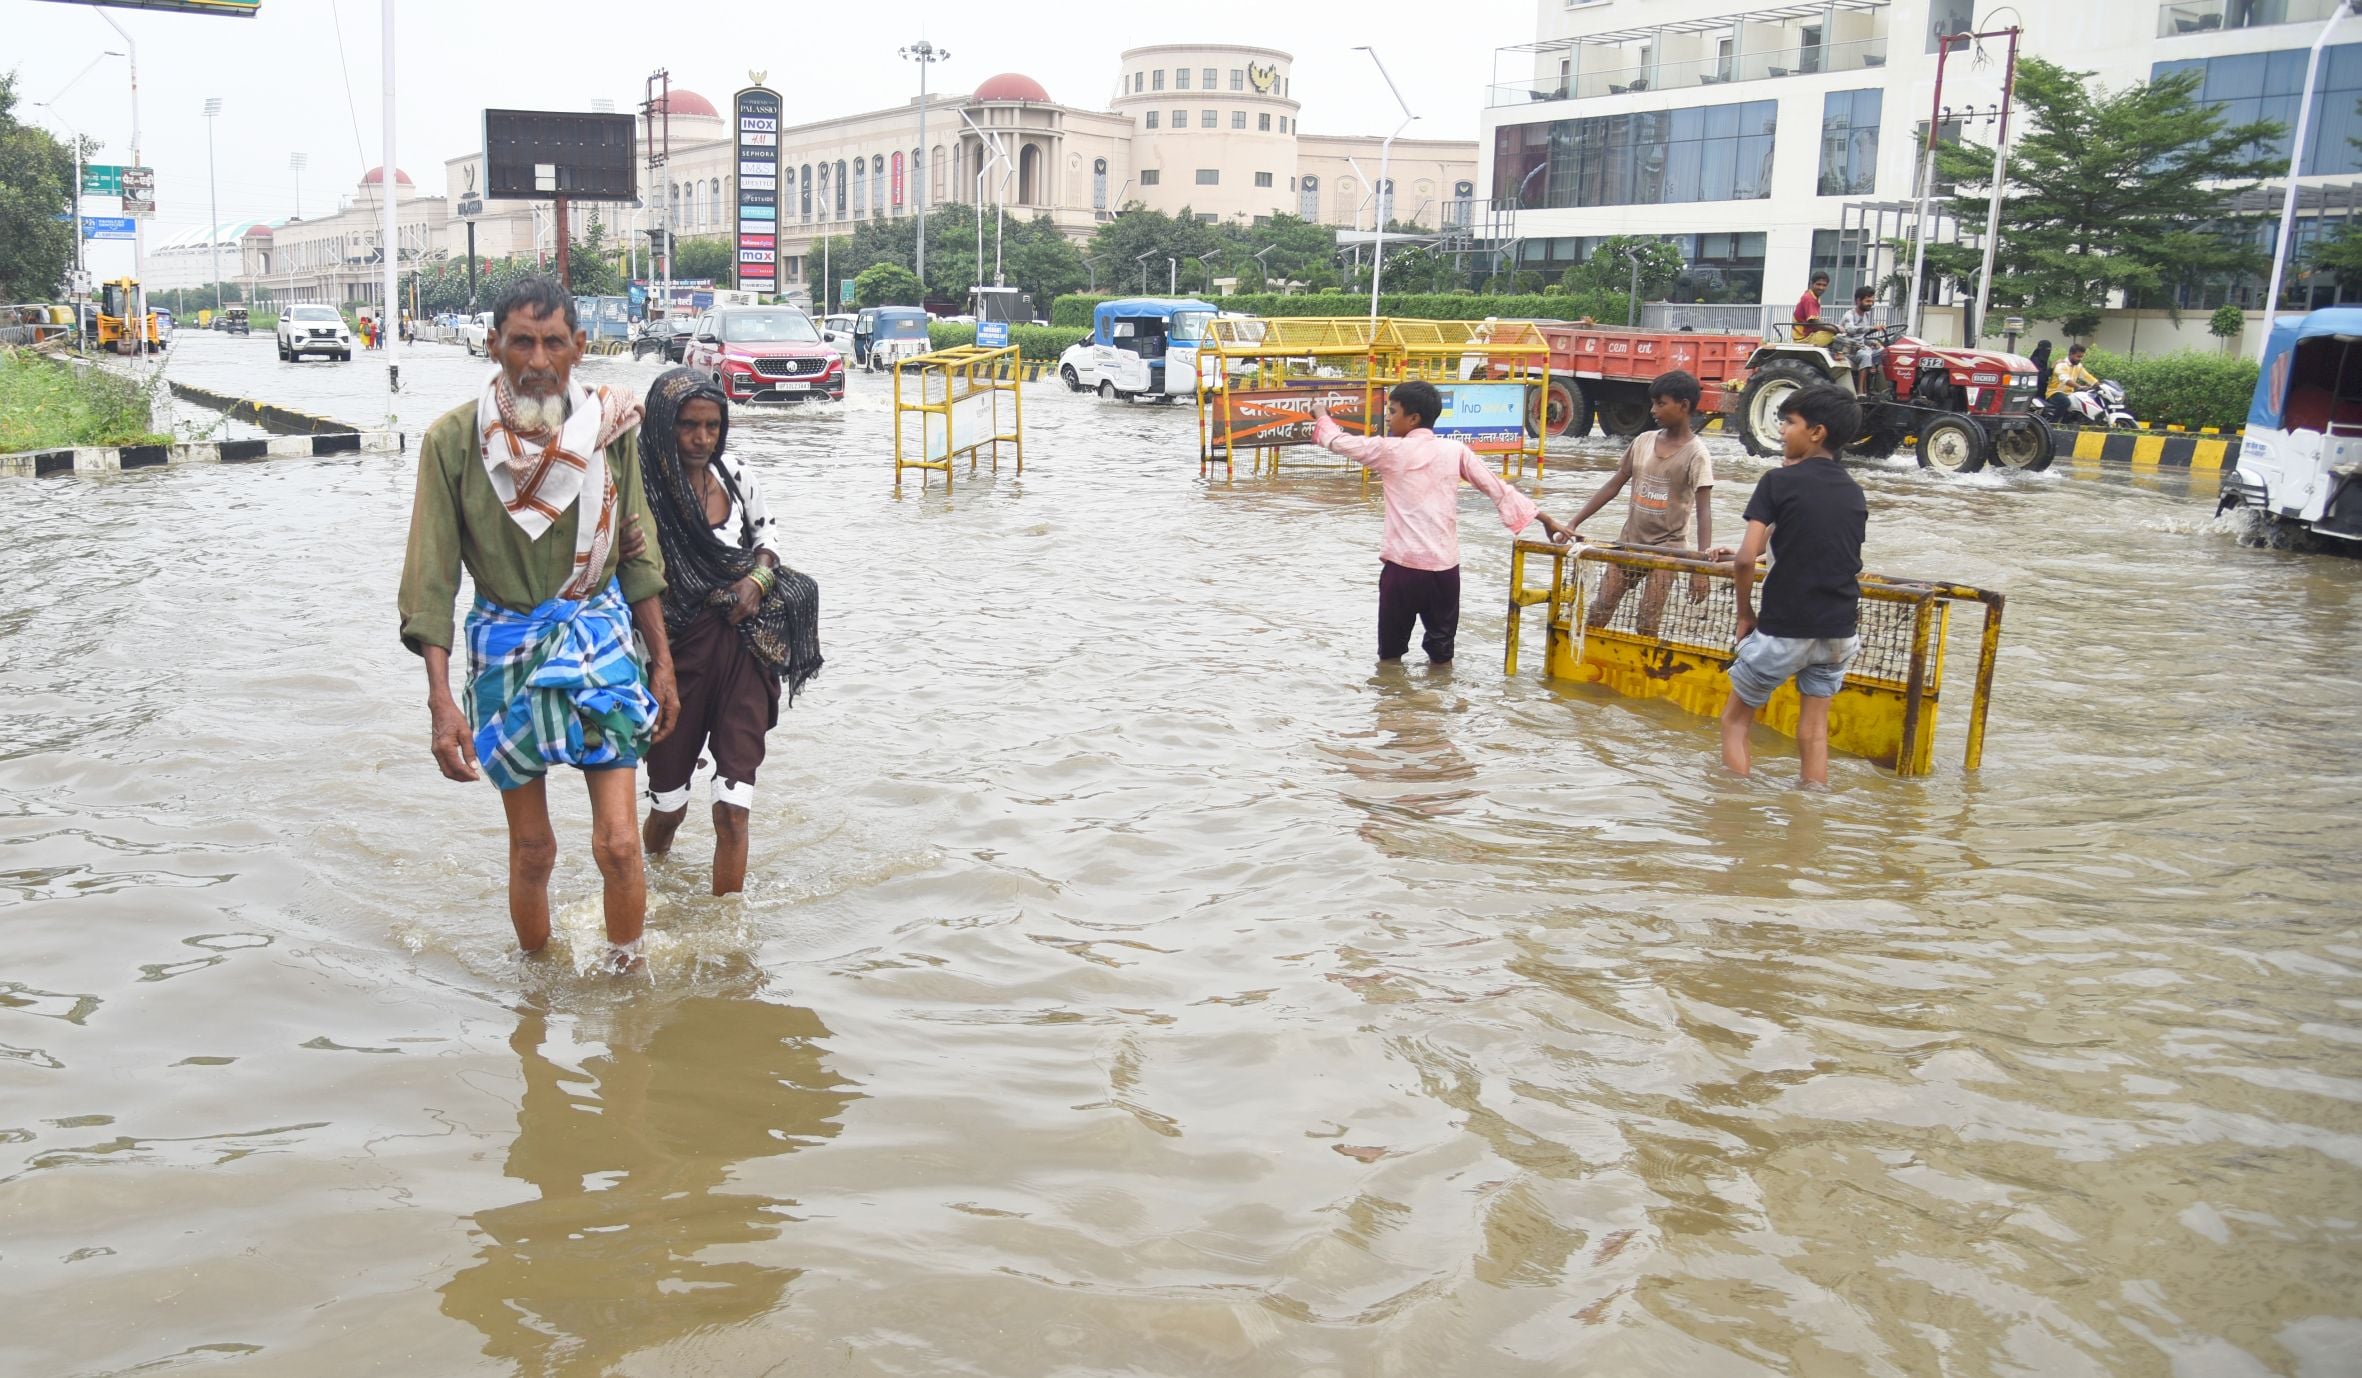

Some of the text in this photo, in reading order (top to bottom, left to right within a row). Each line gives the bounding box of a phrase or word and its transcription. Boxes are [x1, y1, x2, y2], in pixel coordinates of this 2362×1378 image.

[740, 105, 777, 113] PALASSIO
[743, 120, 773, 130] INOX
[742, 251, 772, 260] max
[1921, 358, 1943, 368] 312
[1973, 374, 1996, 382] EICHER
